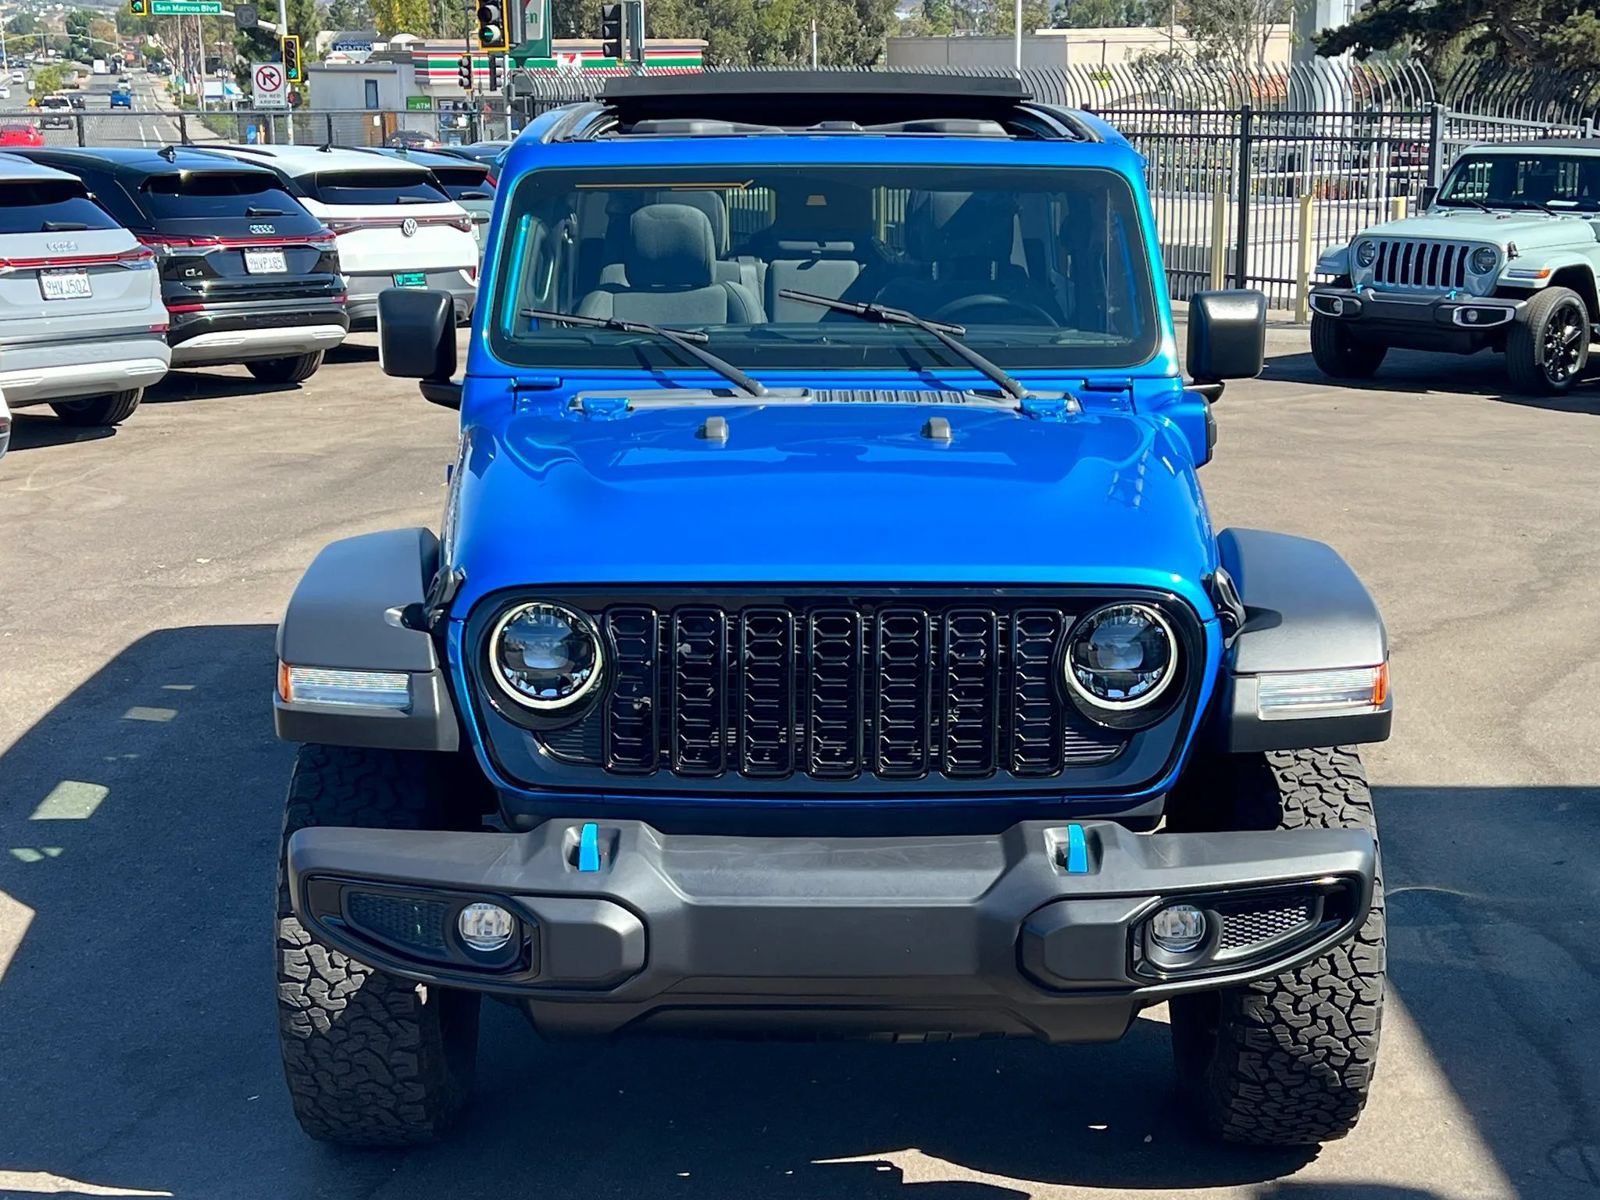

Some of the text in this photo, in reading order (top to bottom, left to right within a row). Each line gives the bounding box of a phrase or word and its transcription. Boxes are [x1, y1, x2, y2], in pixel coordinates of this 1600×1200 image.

[155, 4, 218, 13] San Marcos Blvd
[562, 53, 576, 63] 7
[415, 102, 430, 110] ATM
